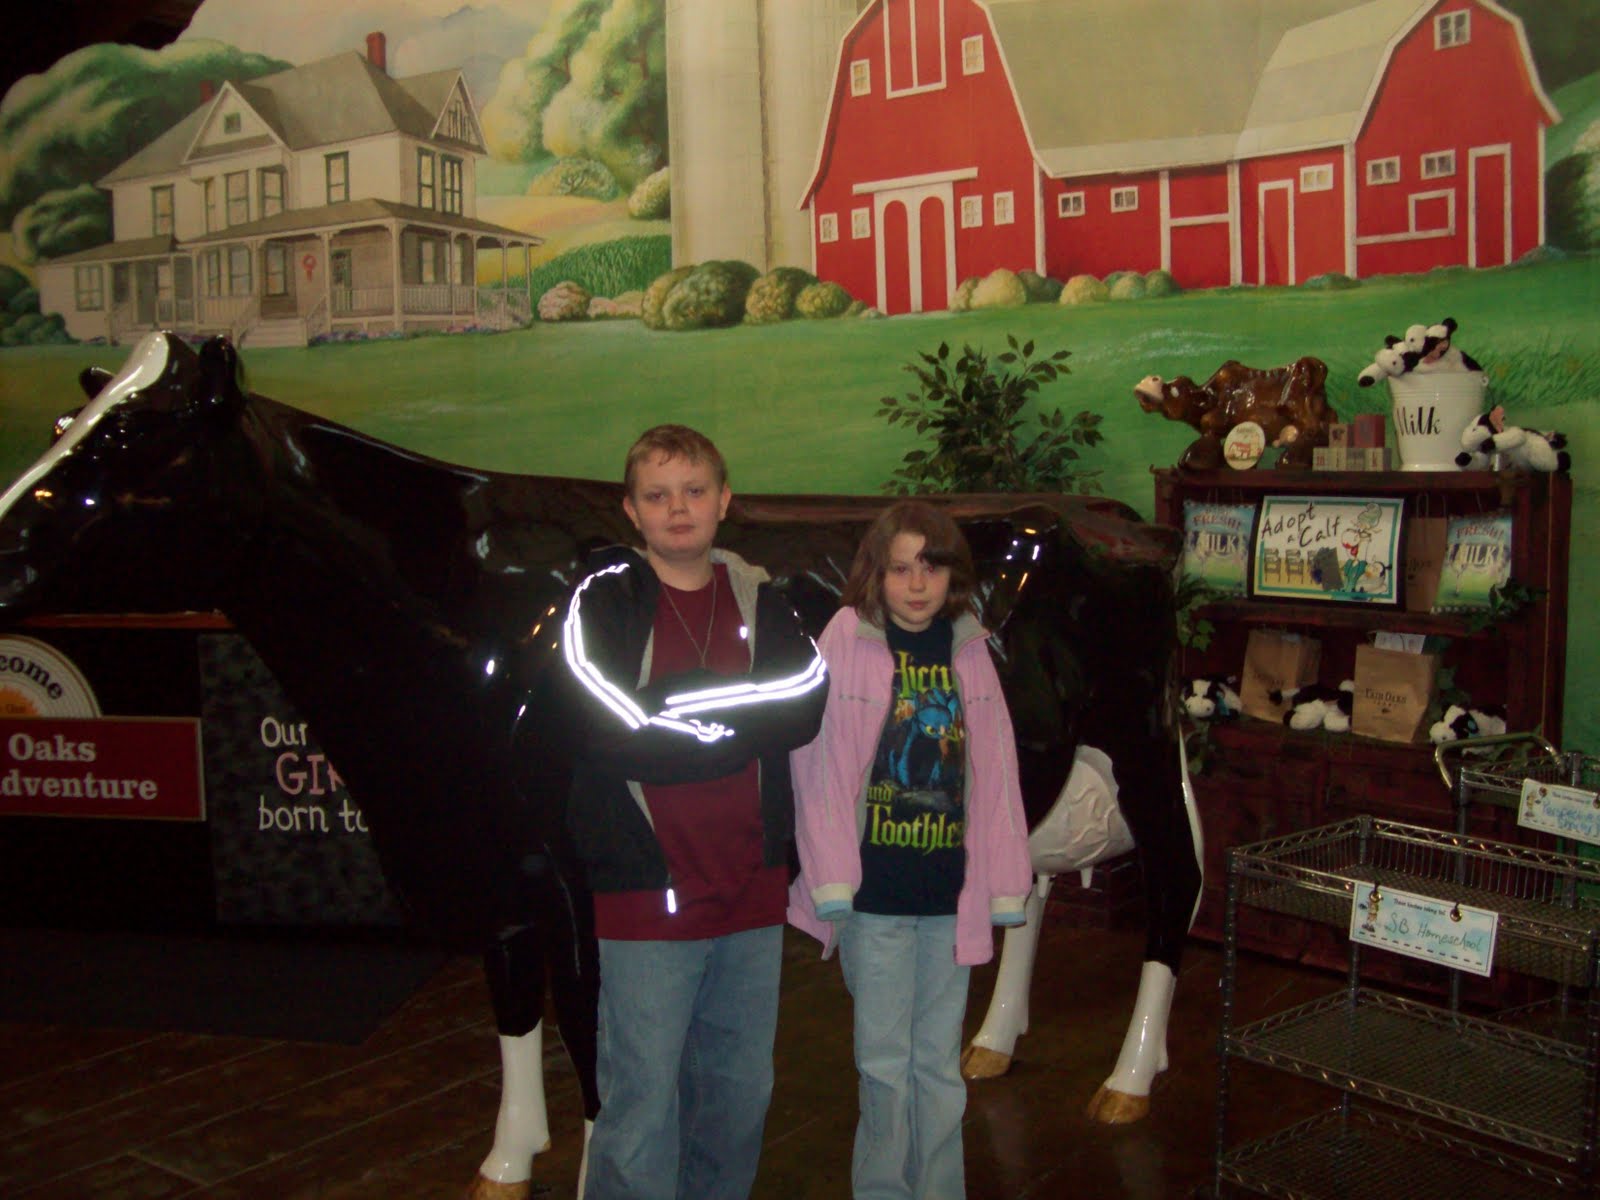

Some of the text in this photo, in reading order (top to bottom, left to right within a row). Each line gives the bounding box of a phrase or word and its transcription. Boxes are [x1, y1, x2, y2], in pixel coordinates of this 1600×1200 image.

[1262, 502, 1316, 539] Adopt
[1299, 515, 1341, 547] Calf
[8, 732, 97, 763] Oaks
[260, 716, 308, 748] Our
[258, 795, 329, 832] born
